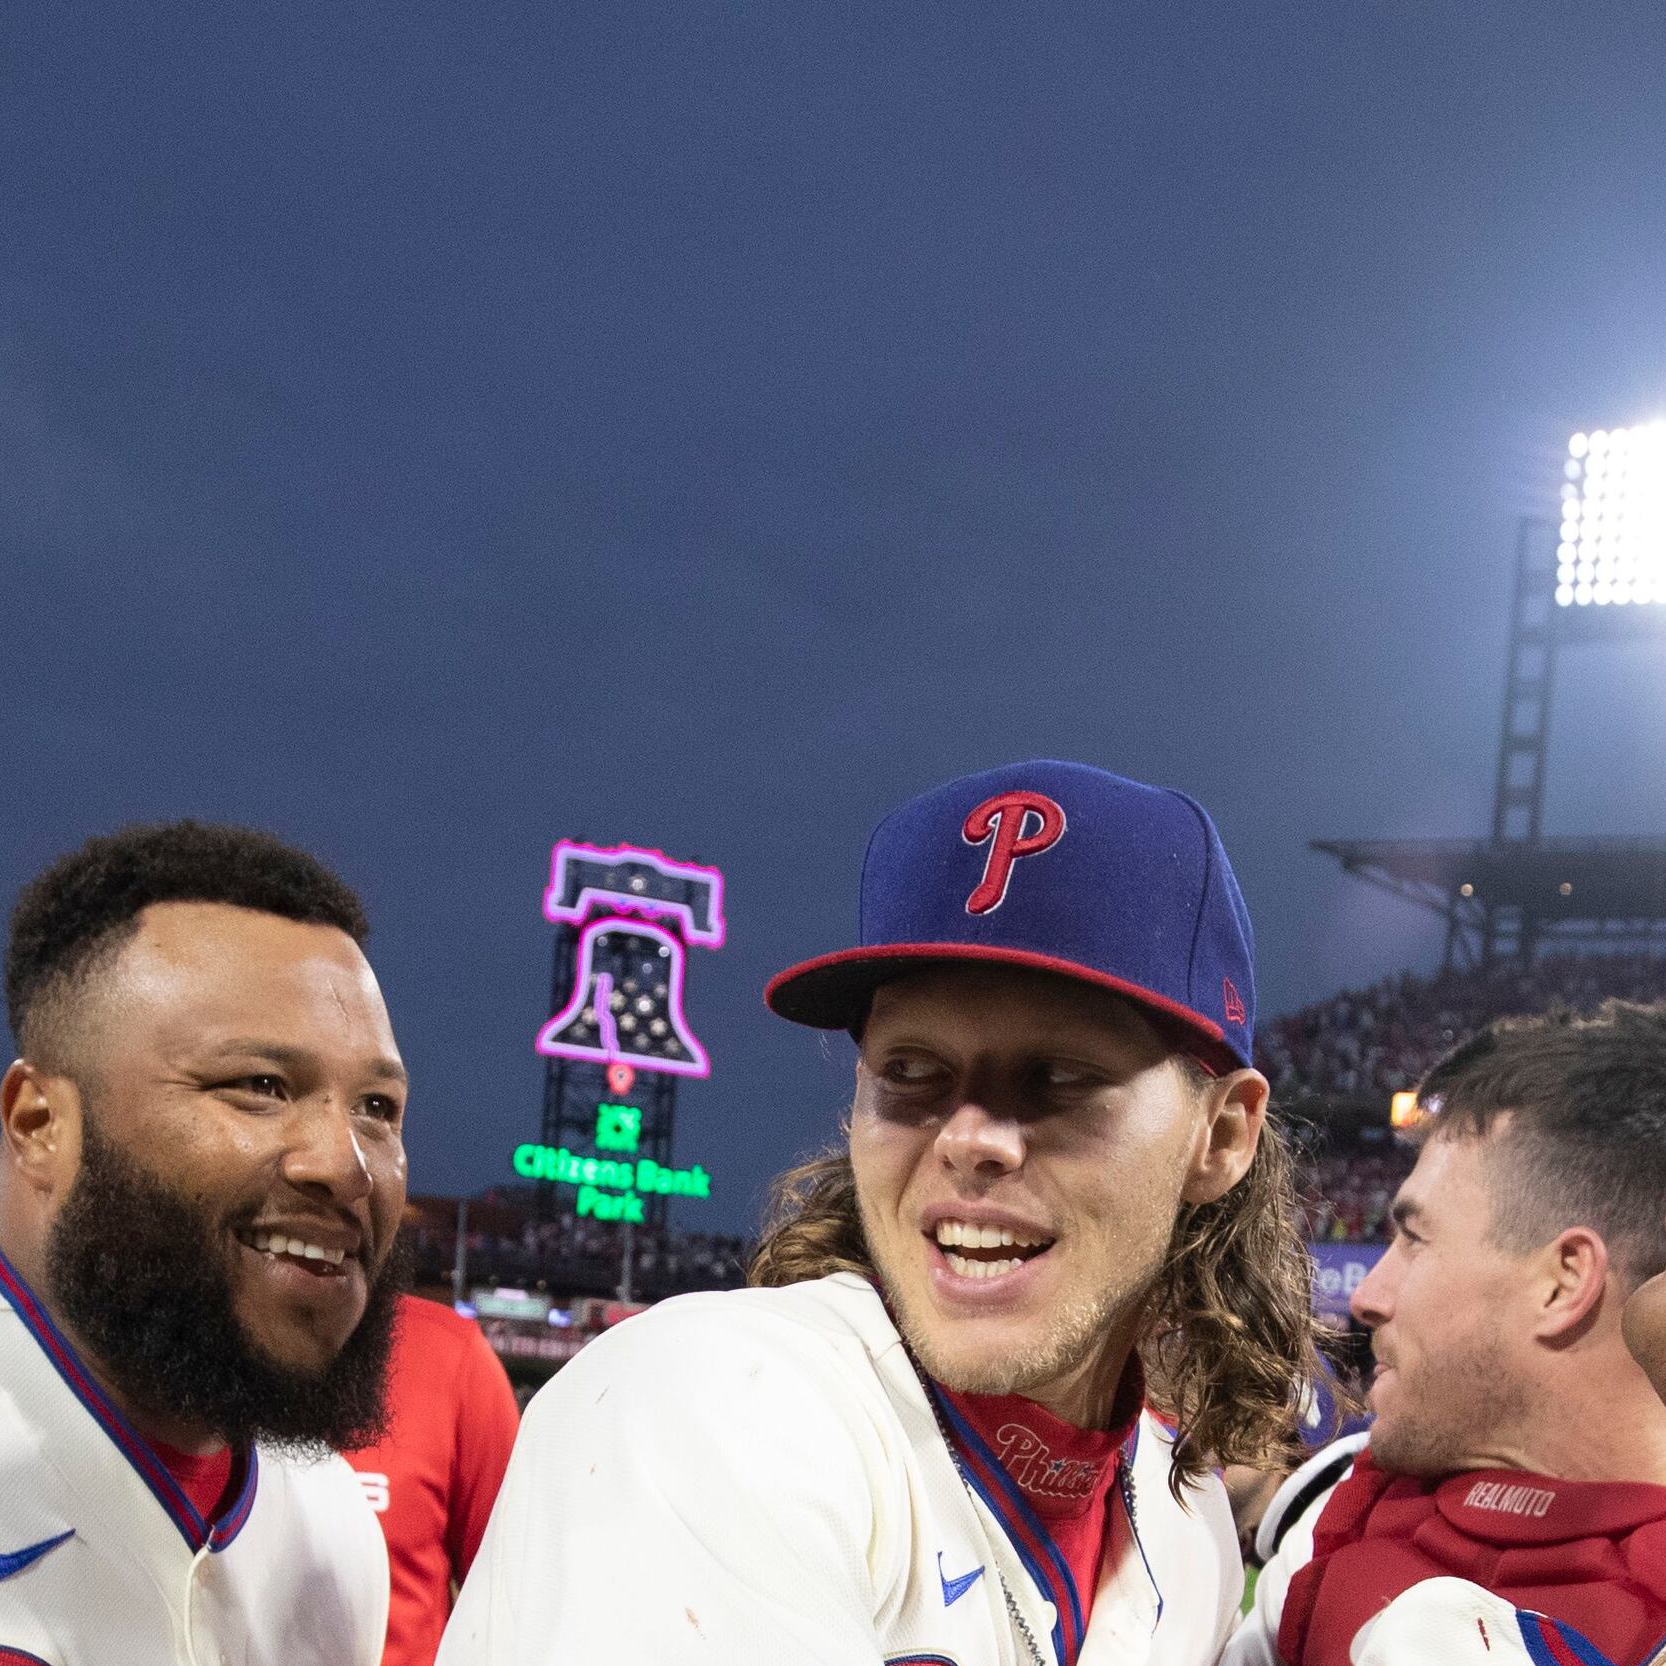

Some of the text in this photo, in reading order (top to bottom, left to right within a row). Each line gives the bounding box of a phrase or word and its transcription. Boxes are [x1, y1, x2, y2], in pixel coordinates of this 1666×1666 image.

[962, 790, 1067, 916] P
[512, 1143, 711, 1199] Citizens Bank
[575, 1184, 645, 1223] Park
[1464, 1481, 1556, 1518] REALMUTO
